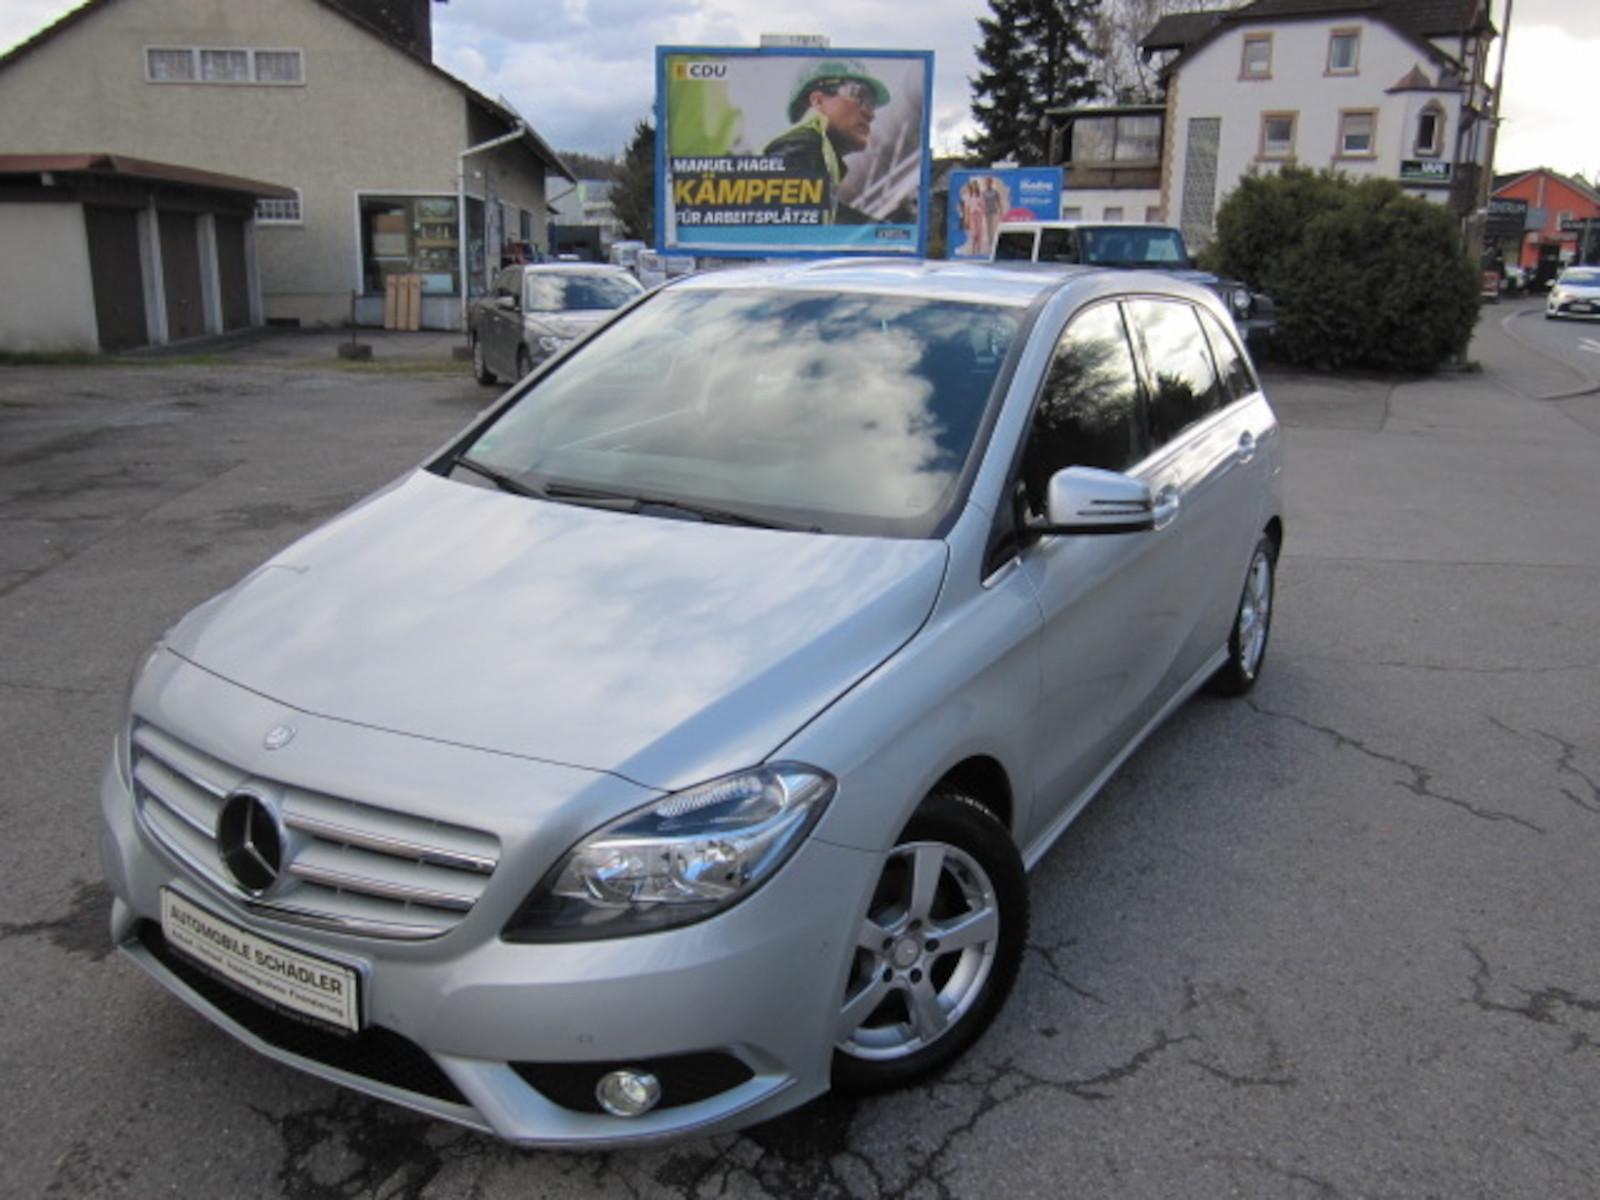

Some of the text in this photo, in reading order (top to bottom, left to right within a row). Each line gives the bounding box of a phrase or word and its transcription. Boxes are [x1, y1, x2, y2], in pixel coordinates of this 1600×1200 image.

[690, 64, 727, 77] CDU
[673, 158, 786, 172] MANUEL HAGEL
[674, 172, 824, 206] KÄMPFEN
[675, 207, 820, 224] FÜR ARBEITSPLÄTZE
[170, 905, 251, 961] AUTOMOBILE
